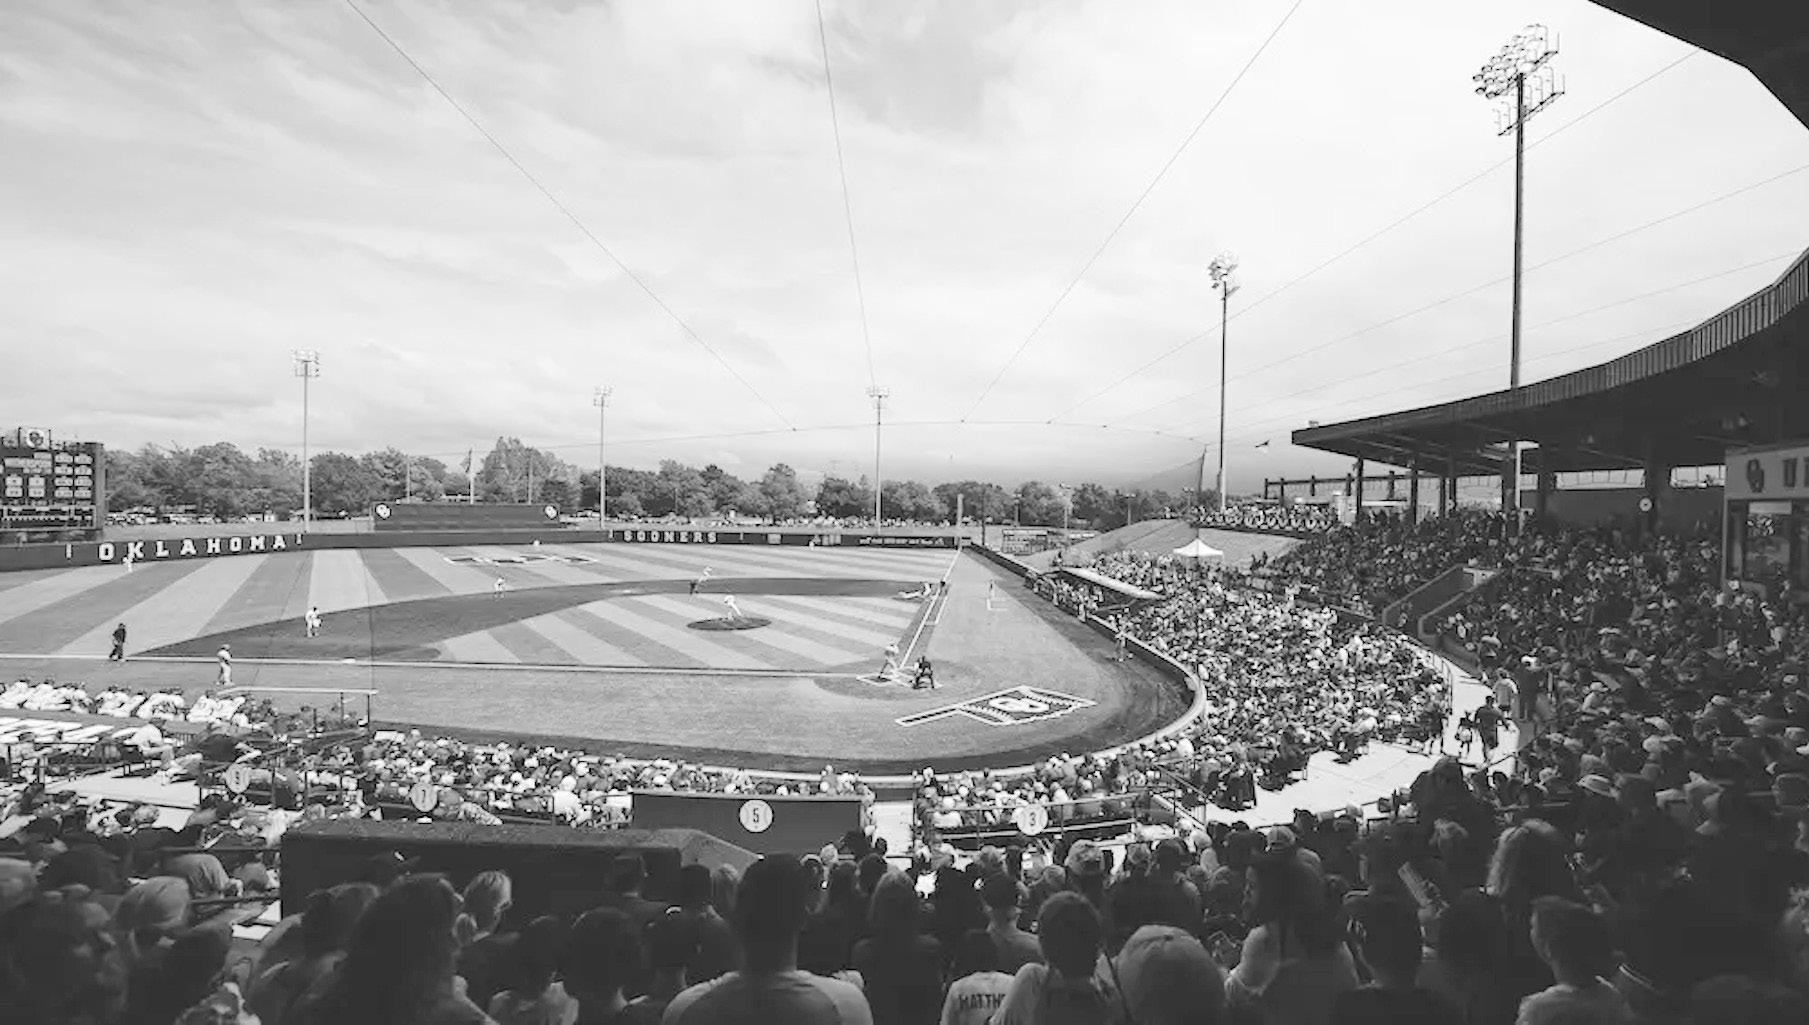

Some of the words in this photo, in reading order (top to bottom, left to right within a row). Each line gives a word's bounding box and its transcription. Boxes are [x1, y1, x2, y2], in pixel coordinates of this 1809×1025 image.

[623, 530, 717, 543] SOONERS
[100, 534, 286, 561] OKLAHOMA
[753, 807, 760, 823] 5
[1029, 811, 1037, 827] 3
[958, 993, 1006, 1009] MATTH
